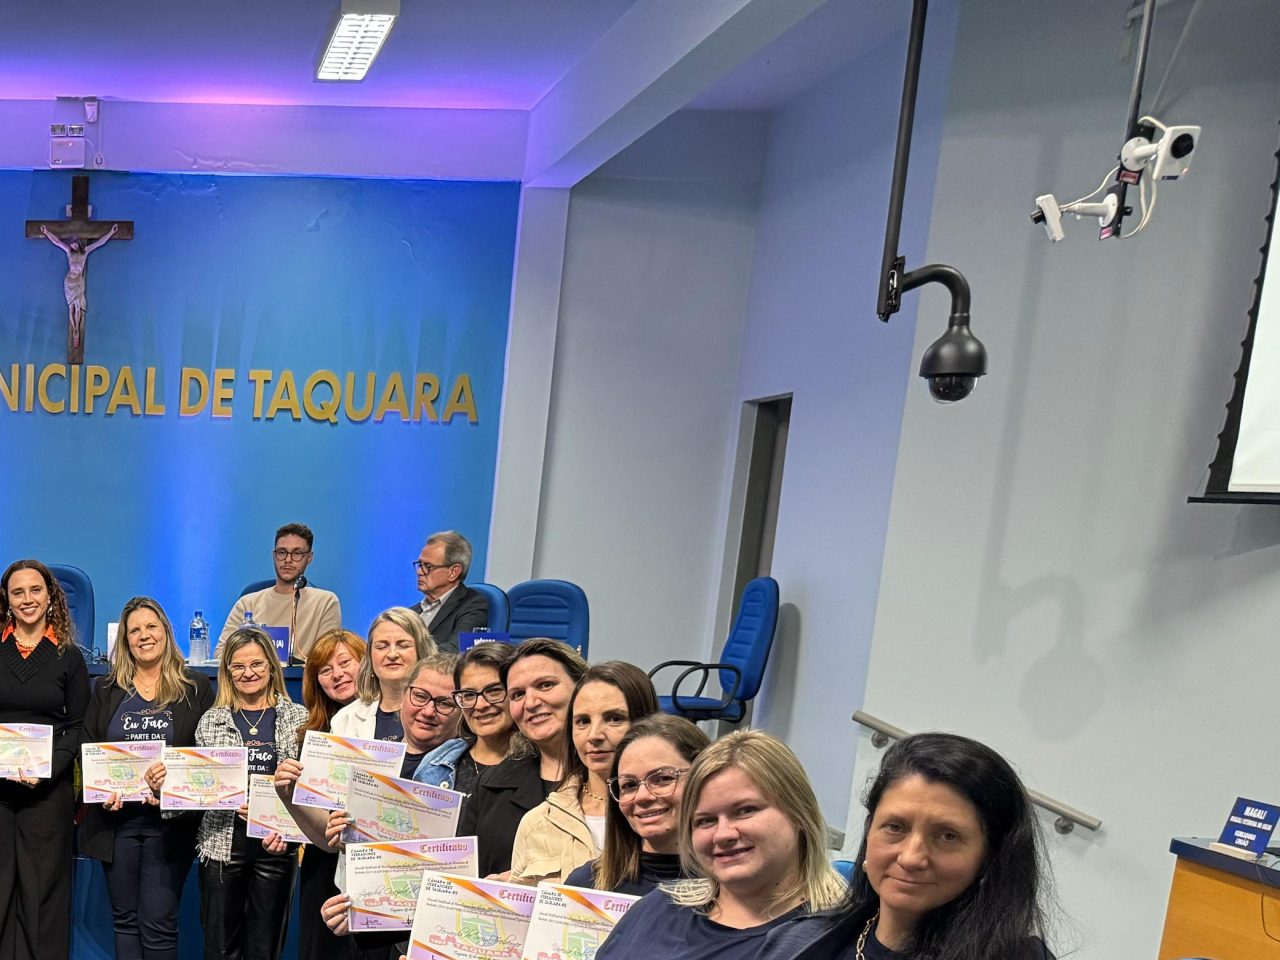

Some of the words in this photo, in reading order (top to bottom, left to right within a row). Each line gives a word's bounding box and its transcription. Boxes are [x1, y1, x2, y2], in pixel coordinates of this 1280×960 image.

[178, 367, 234, 418] DE
[248, 369, 479, 425] TAQUARA
[123, 717, 139, 730] Eu
[142, 716, 171, 731] Faço
[130, 733, 150, 741] PARTE
[419, 843, 468, 854] Certificado
[499, 889, 536, 904] Certific
